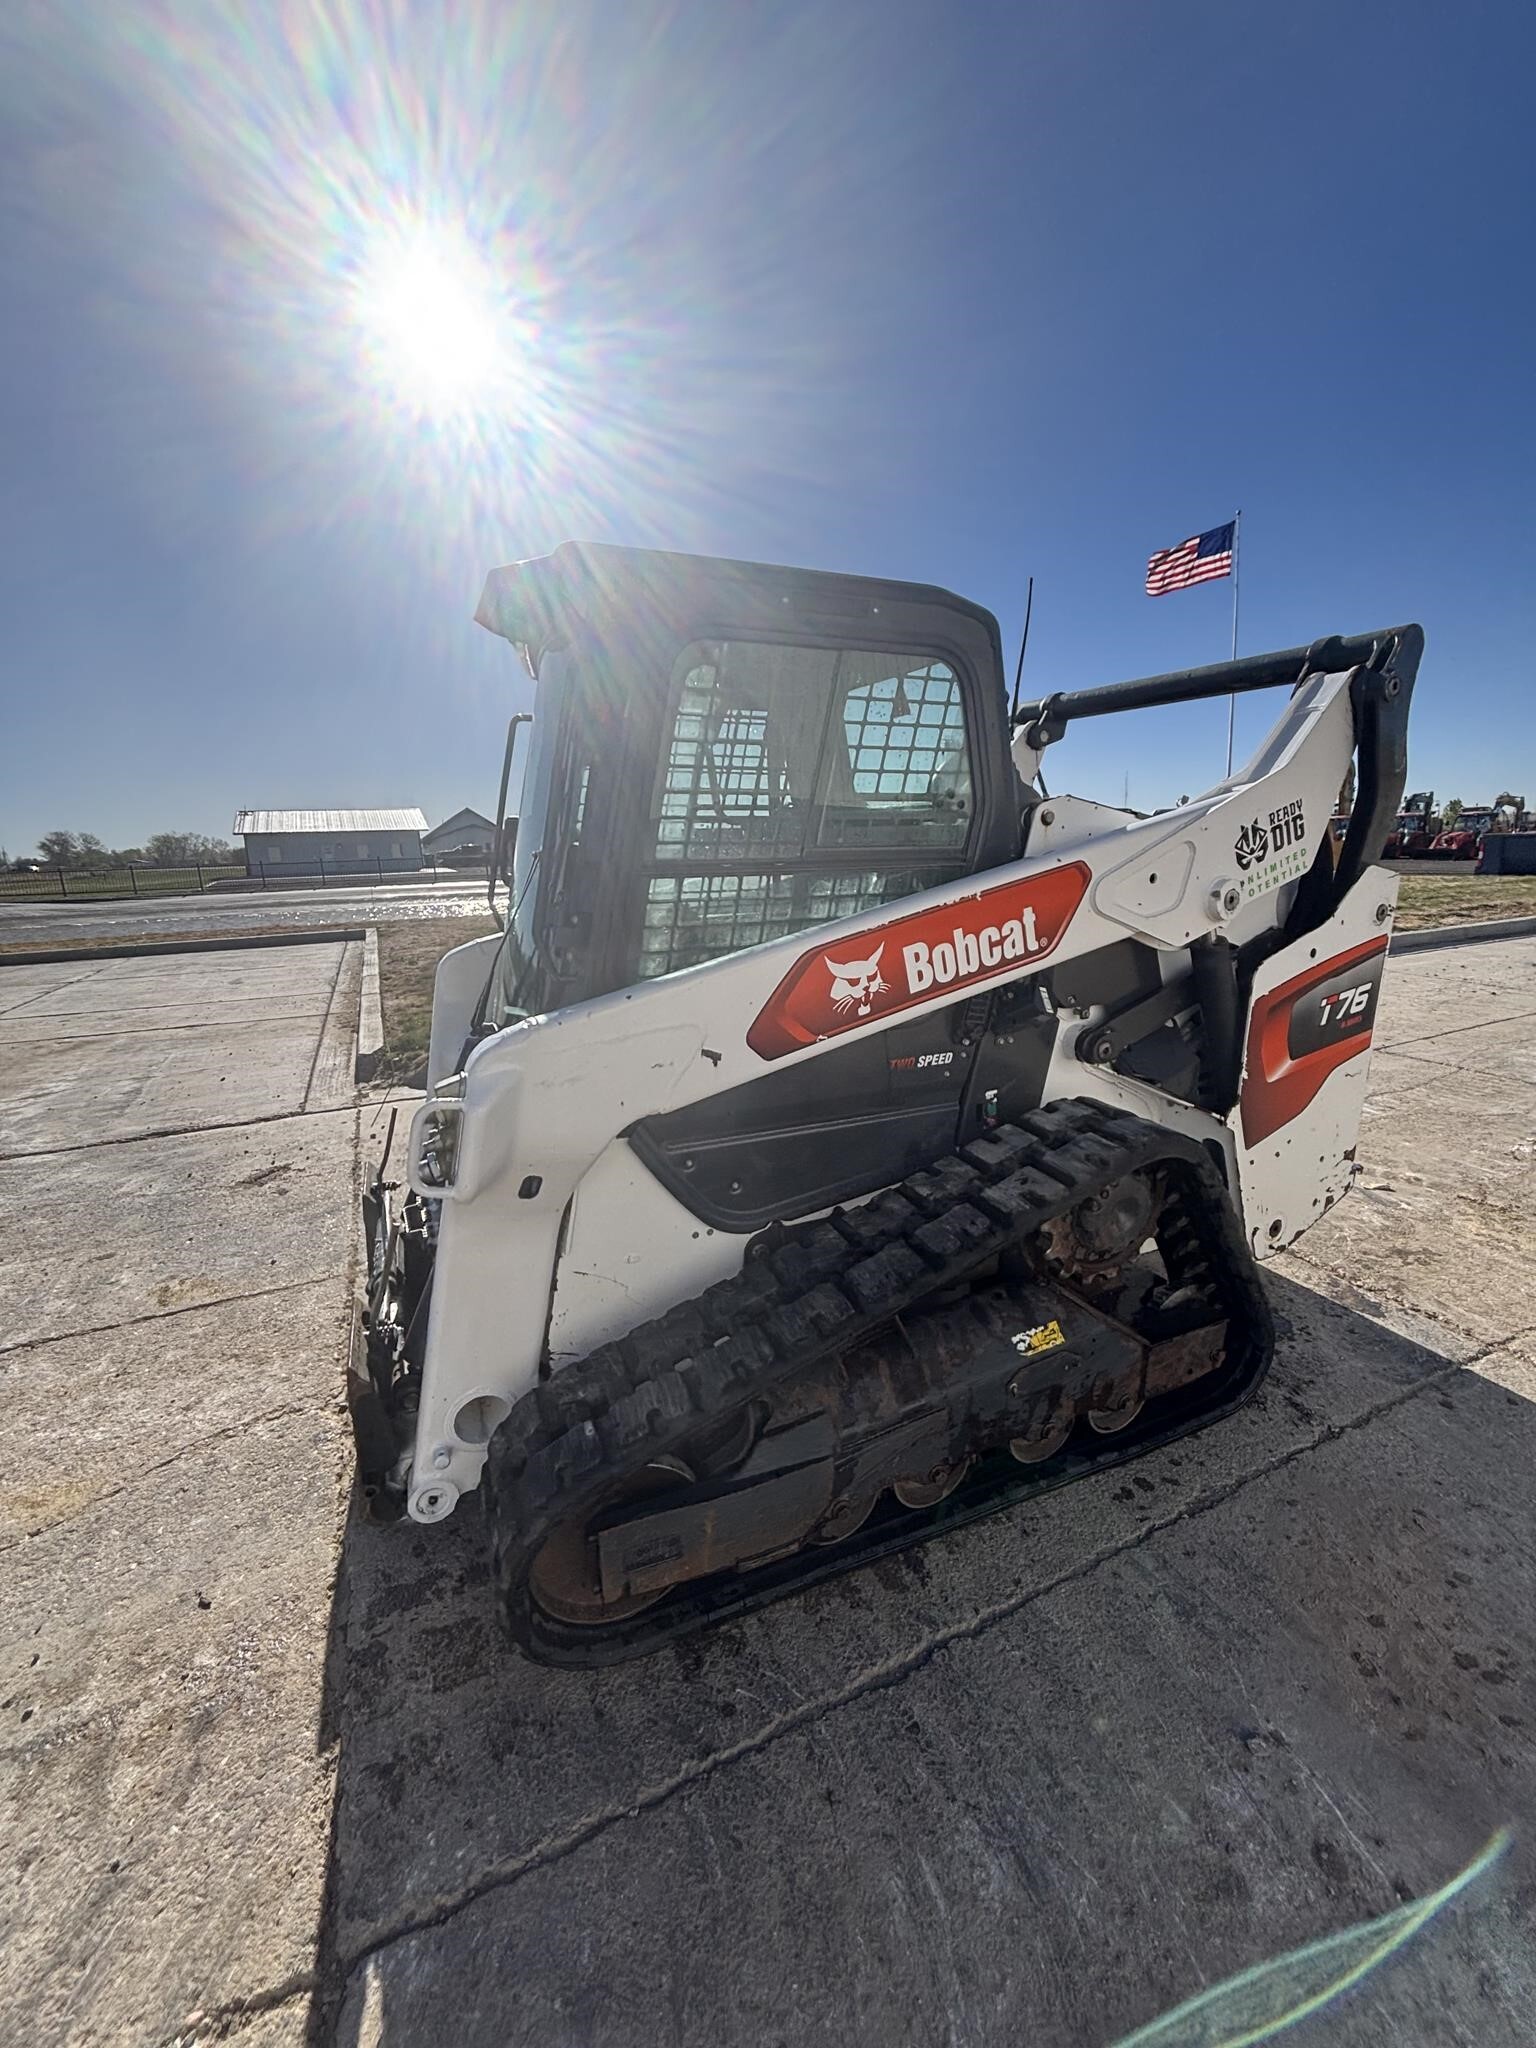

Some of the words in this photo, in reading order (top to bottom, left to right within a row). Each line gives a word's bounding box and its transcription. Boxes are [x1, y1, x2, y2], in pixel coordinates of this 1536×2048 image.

[1268, 798, 1303, 826] READY
[1270, 813, 1305, 852] DIG
[1246, 847, 1308, 886] NLIMITED
[1247, 860, 1309, 898] OTENTIAL
[902, 906, 1039, 994] Bobcat
[1319, 982, 1373, 1027] T76
[917, 1052, 953, 1068] SPEED
